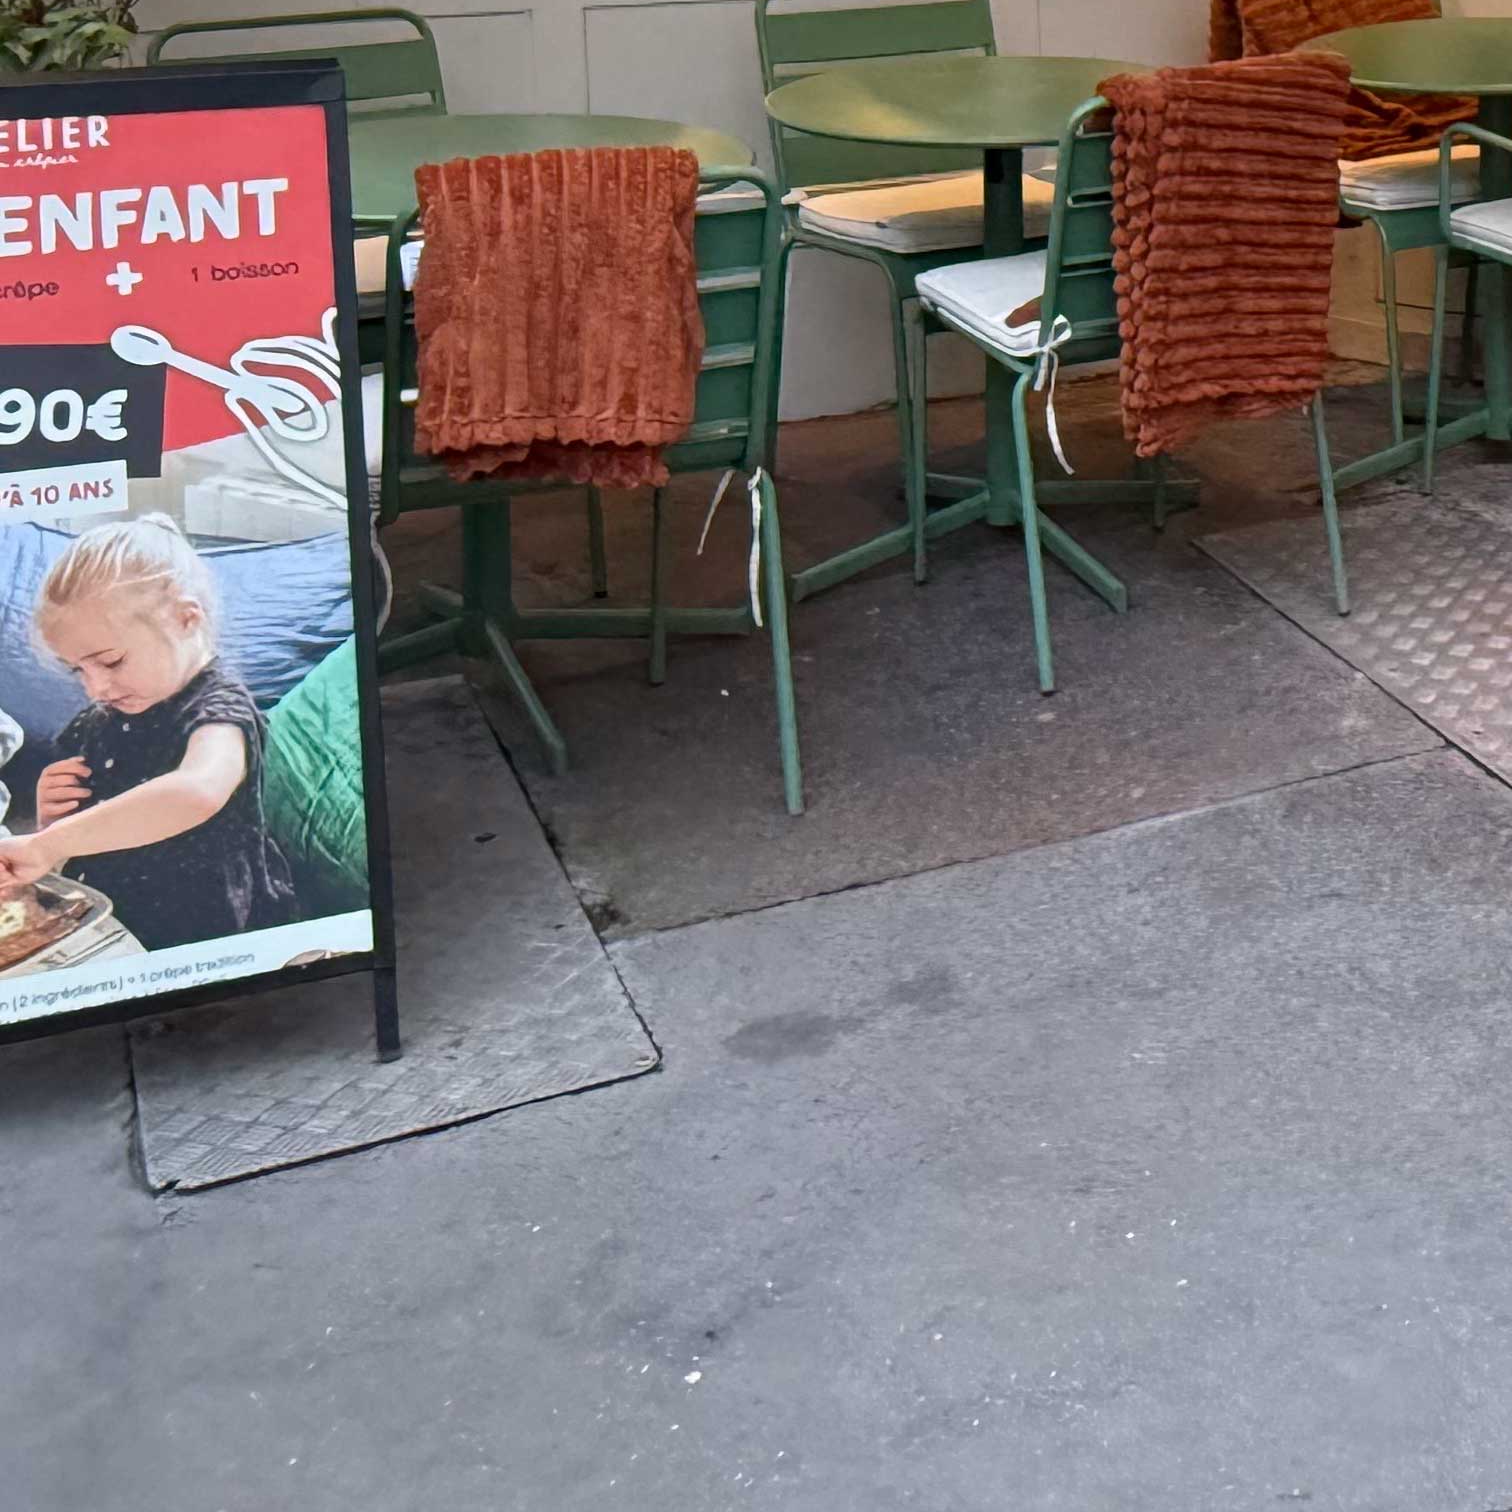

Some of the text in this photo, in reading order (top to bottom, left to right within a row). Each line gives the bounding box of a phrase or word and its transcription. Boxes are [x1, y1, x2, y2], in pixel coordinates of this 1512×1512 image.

[0, 177, 289, 258] ENFANT
[211, 261, 300, 282] boisson
[31, 485, 60, 506] 10
[69, 478, 114, 502] ANS
